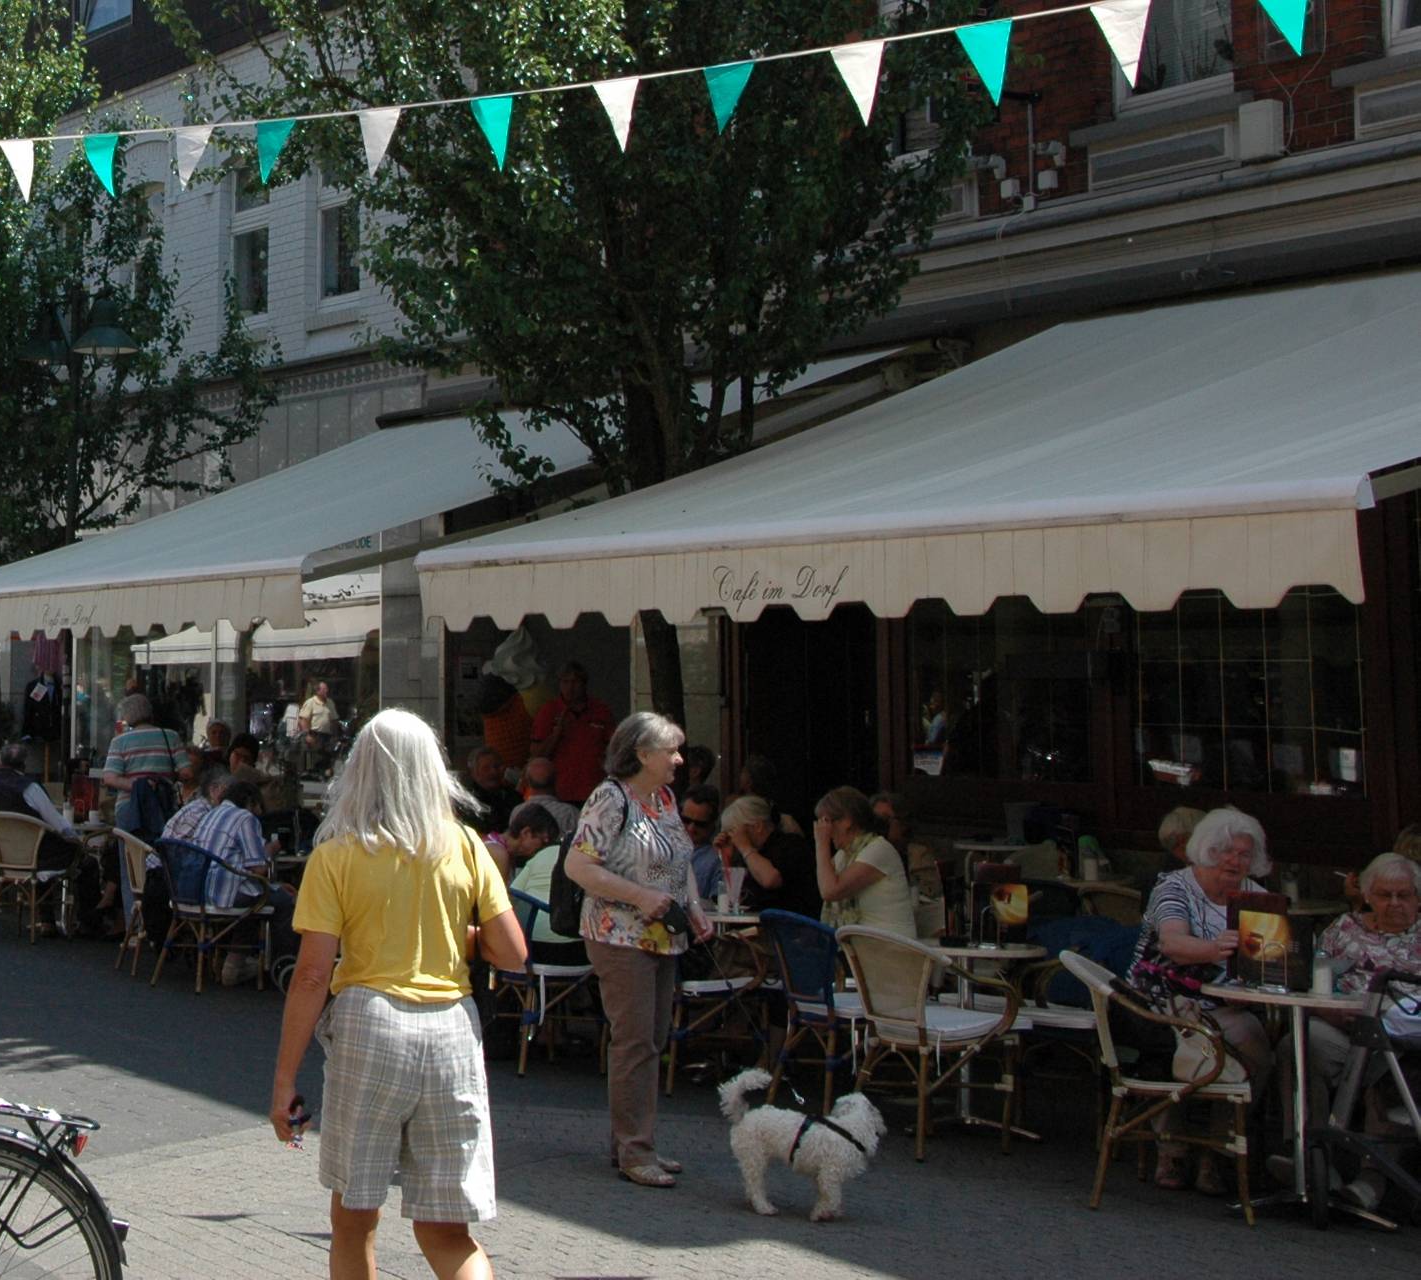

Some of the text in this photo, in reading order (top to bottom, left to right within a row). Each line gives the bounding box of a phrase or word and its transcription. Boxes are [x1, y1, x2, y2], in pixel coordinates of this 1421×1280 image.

[713, 565, 849, 613] Café im Dorf
